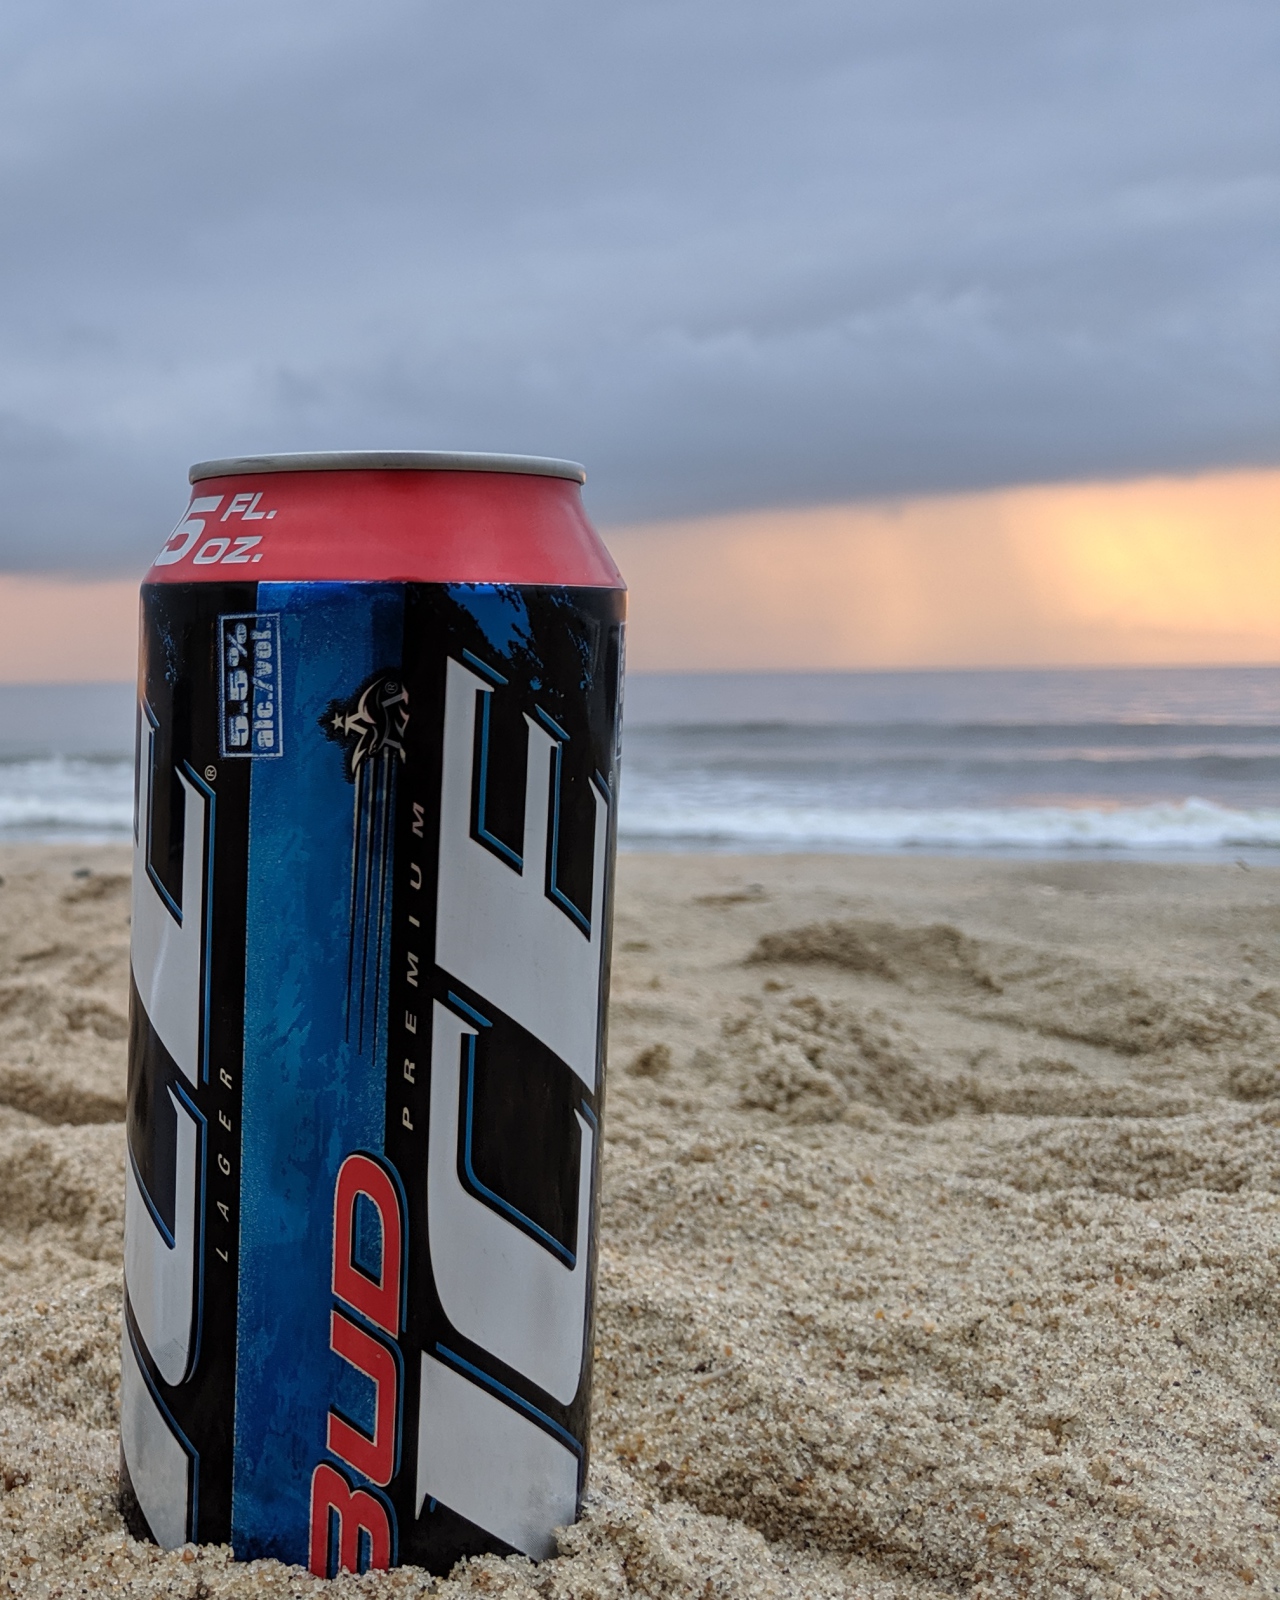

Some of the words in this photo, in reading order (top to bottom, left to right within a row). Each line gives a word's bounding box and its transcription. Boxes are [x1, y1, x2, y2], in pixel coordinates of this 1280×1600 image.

[193, 536, 263, 565] OZ.
[220, 492, 277, 521] FL.
[227, 623, 249, 746] 5.5%
[402, 801, 426, 1131] PREMIUM
[215, 1067, 234, 1262] LAGER
[308, 1153, 403, 1580] BUD
